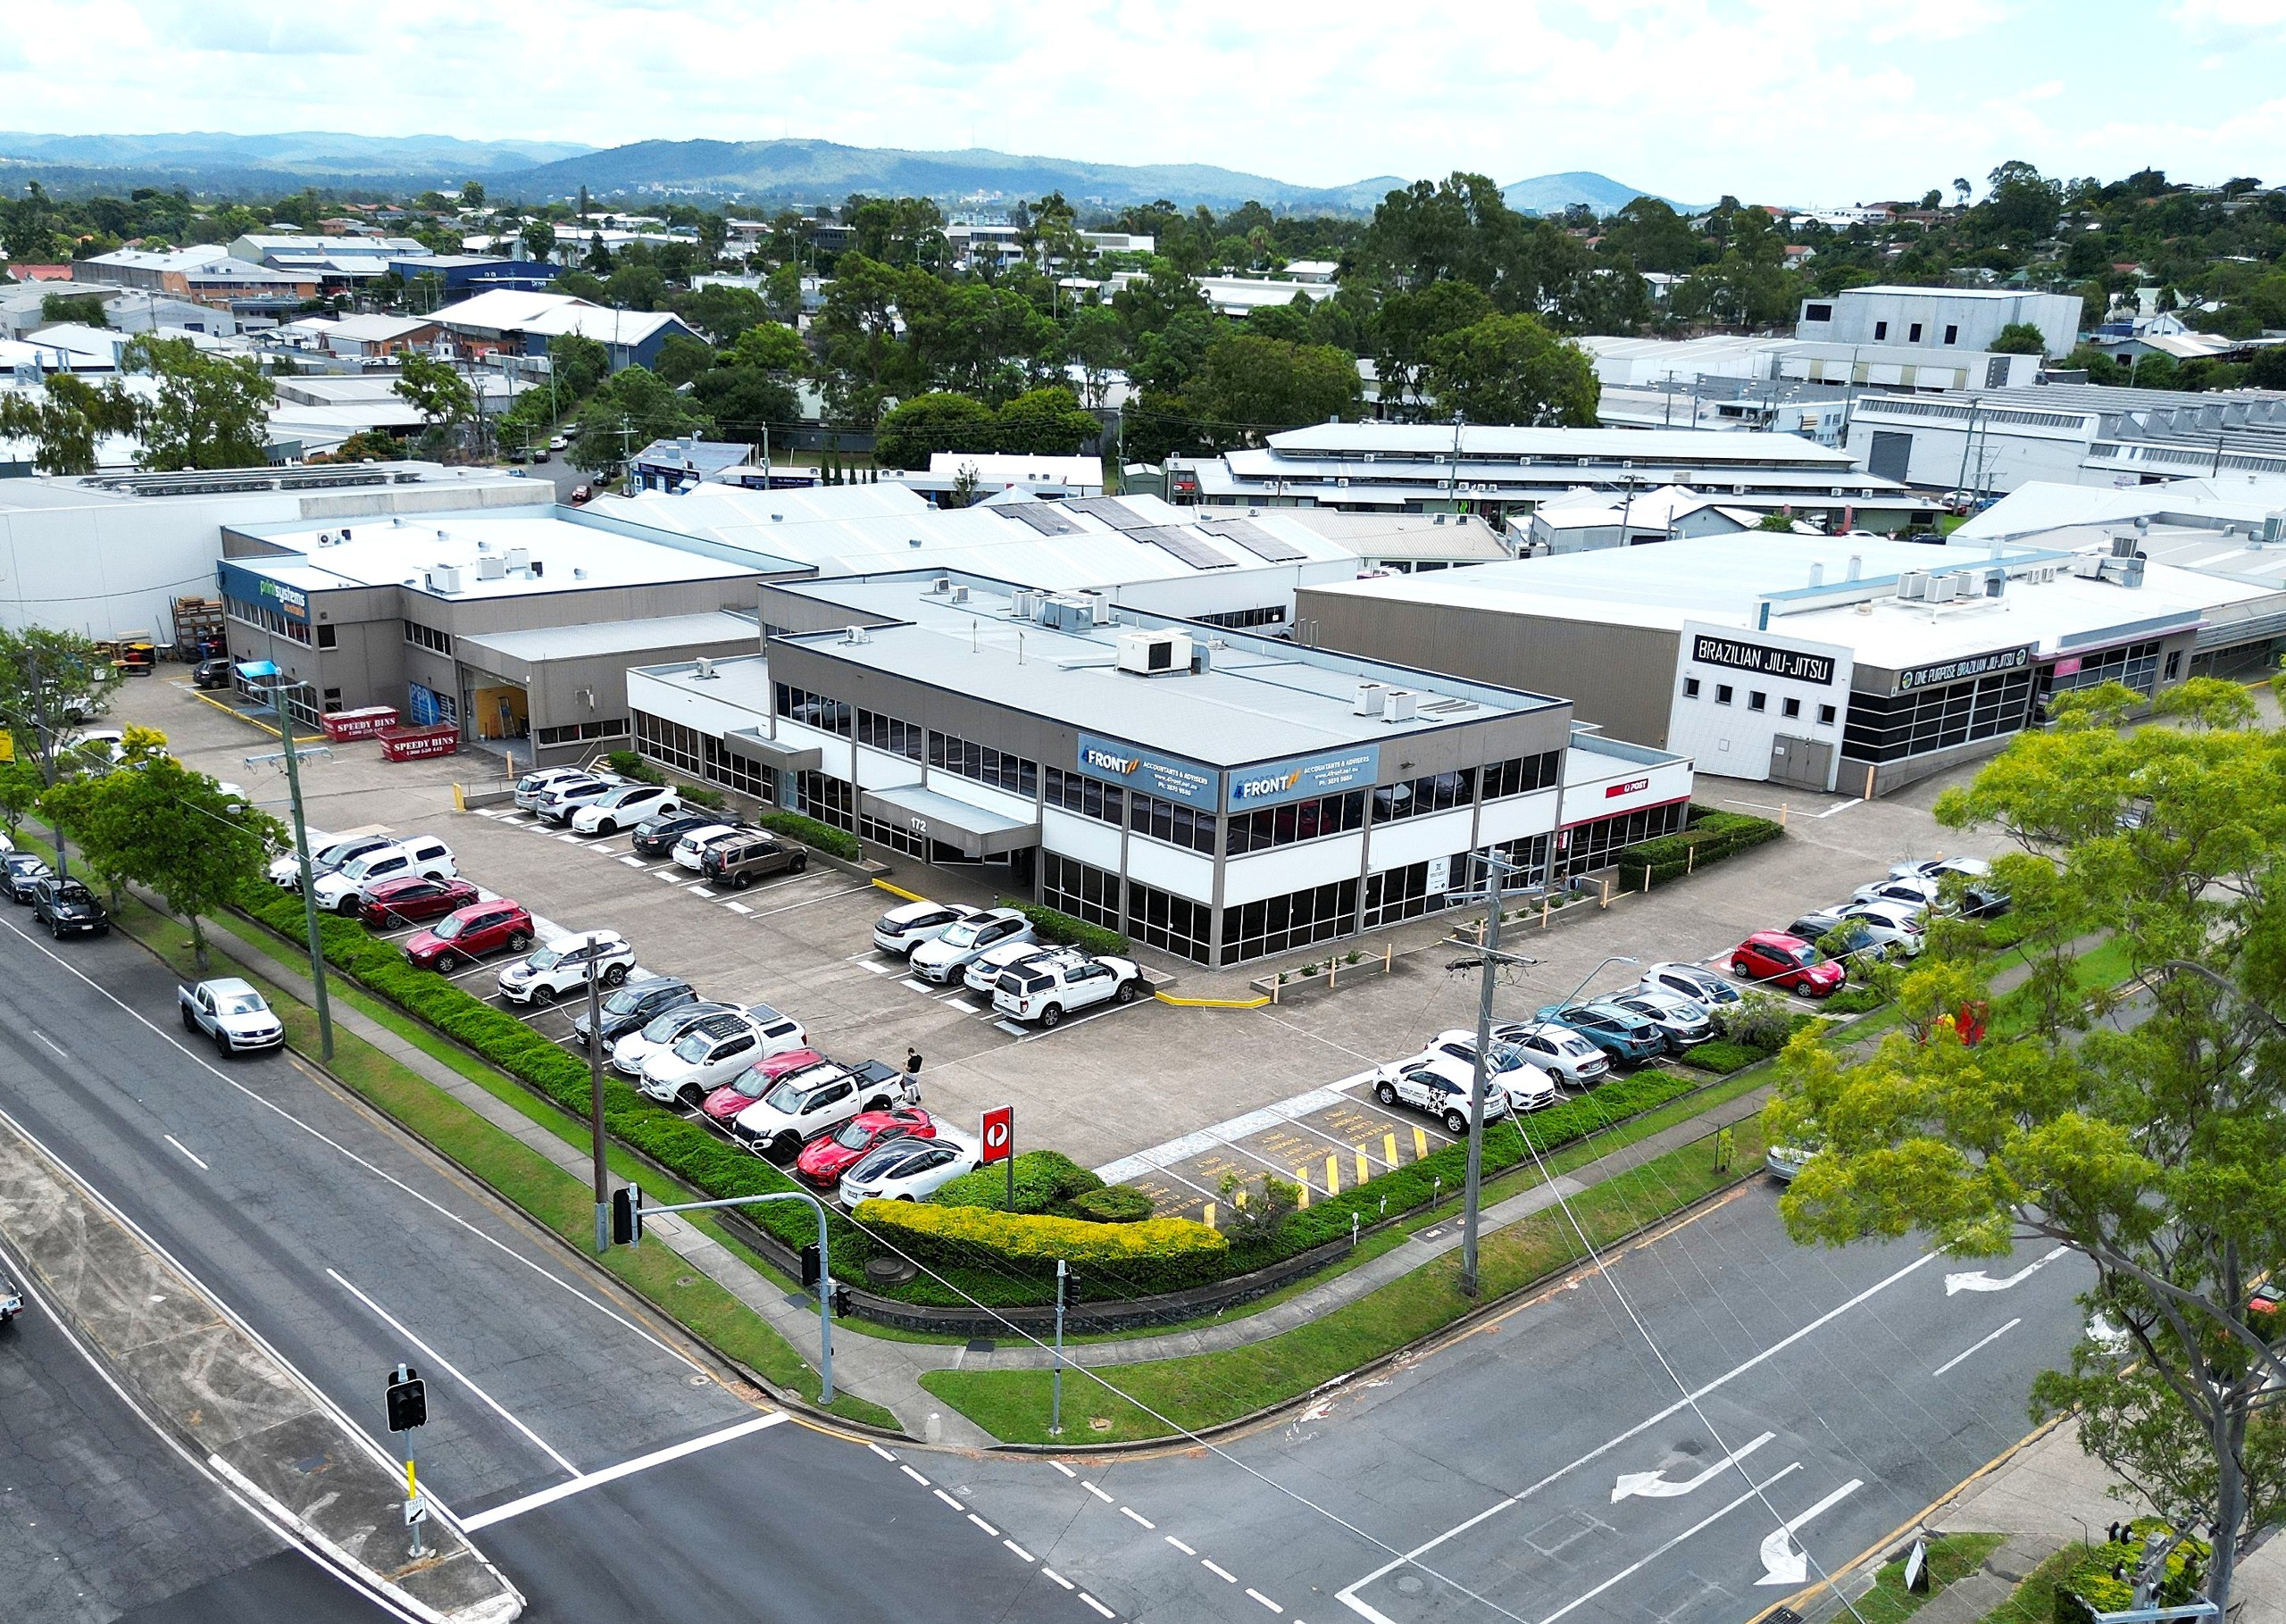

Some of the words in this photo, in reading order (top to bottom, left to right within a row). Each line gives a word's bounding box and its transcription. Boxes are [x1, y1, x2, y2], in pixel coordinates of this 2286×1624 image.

[1698, 639, 1762, 669] BRAZILIAN
[1764, 652, 1829, 680] JIU-JITSU
[1914, 670, 1927, 686] ONE
[1927, 663, 1957, 682] PURPOSE
[1956, 658, 1987, 677] BRAZILIAN
[1987, 652, 2015, 670] JIU-JITSU
[338, 720, 372, 732] SPEEDY
[374, 718, 396, 728] BINS
[394, 739, 430, 752] SPEEDY
[431, 736, 455, 746] BINS
[1631, 780, 1647, 791] POST
[911, 817, 927, 832] 172
